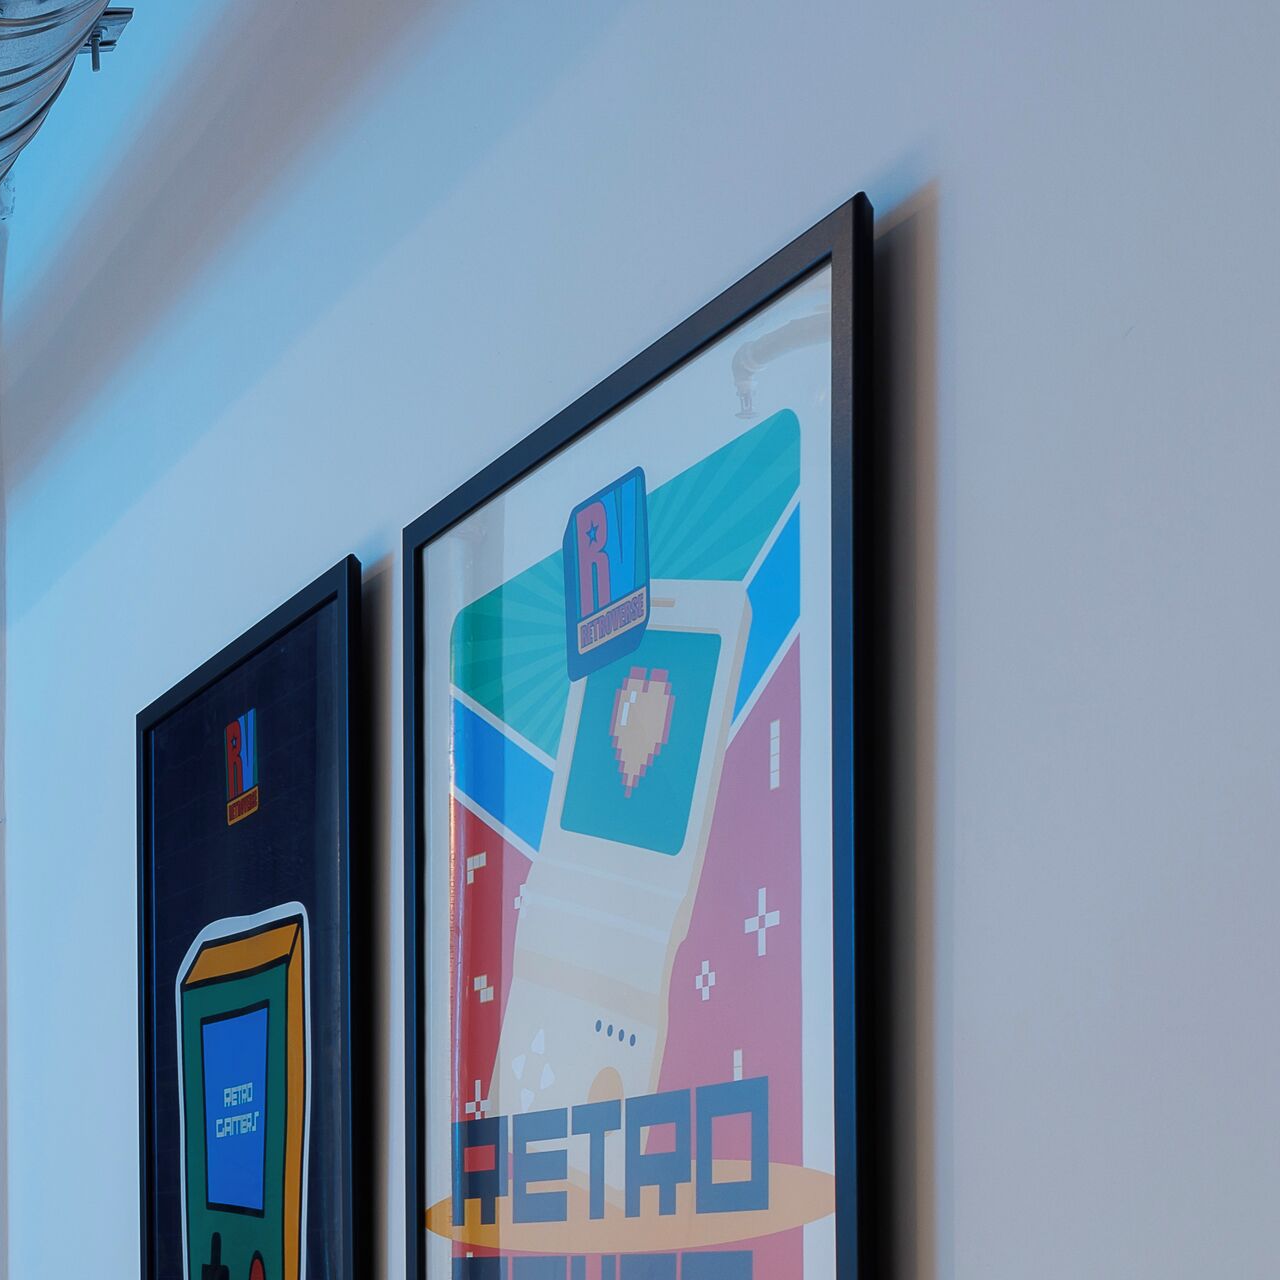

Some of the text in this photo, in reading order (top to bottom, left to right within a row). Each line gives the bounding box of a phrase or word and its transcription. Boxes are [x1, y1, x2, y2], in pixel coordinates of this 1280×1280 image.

[576, 476, 637, 617] RV
[580, 592, 645, 649] RETROVERSE
[225, 707, 257, 801] RV
[223, 1082, 253, 1108] RETRO
[451, 1075, 769, 1227] RETRO
